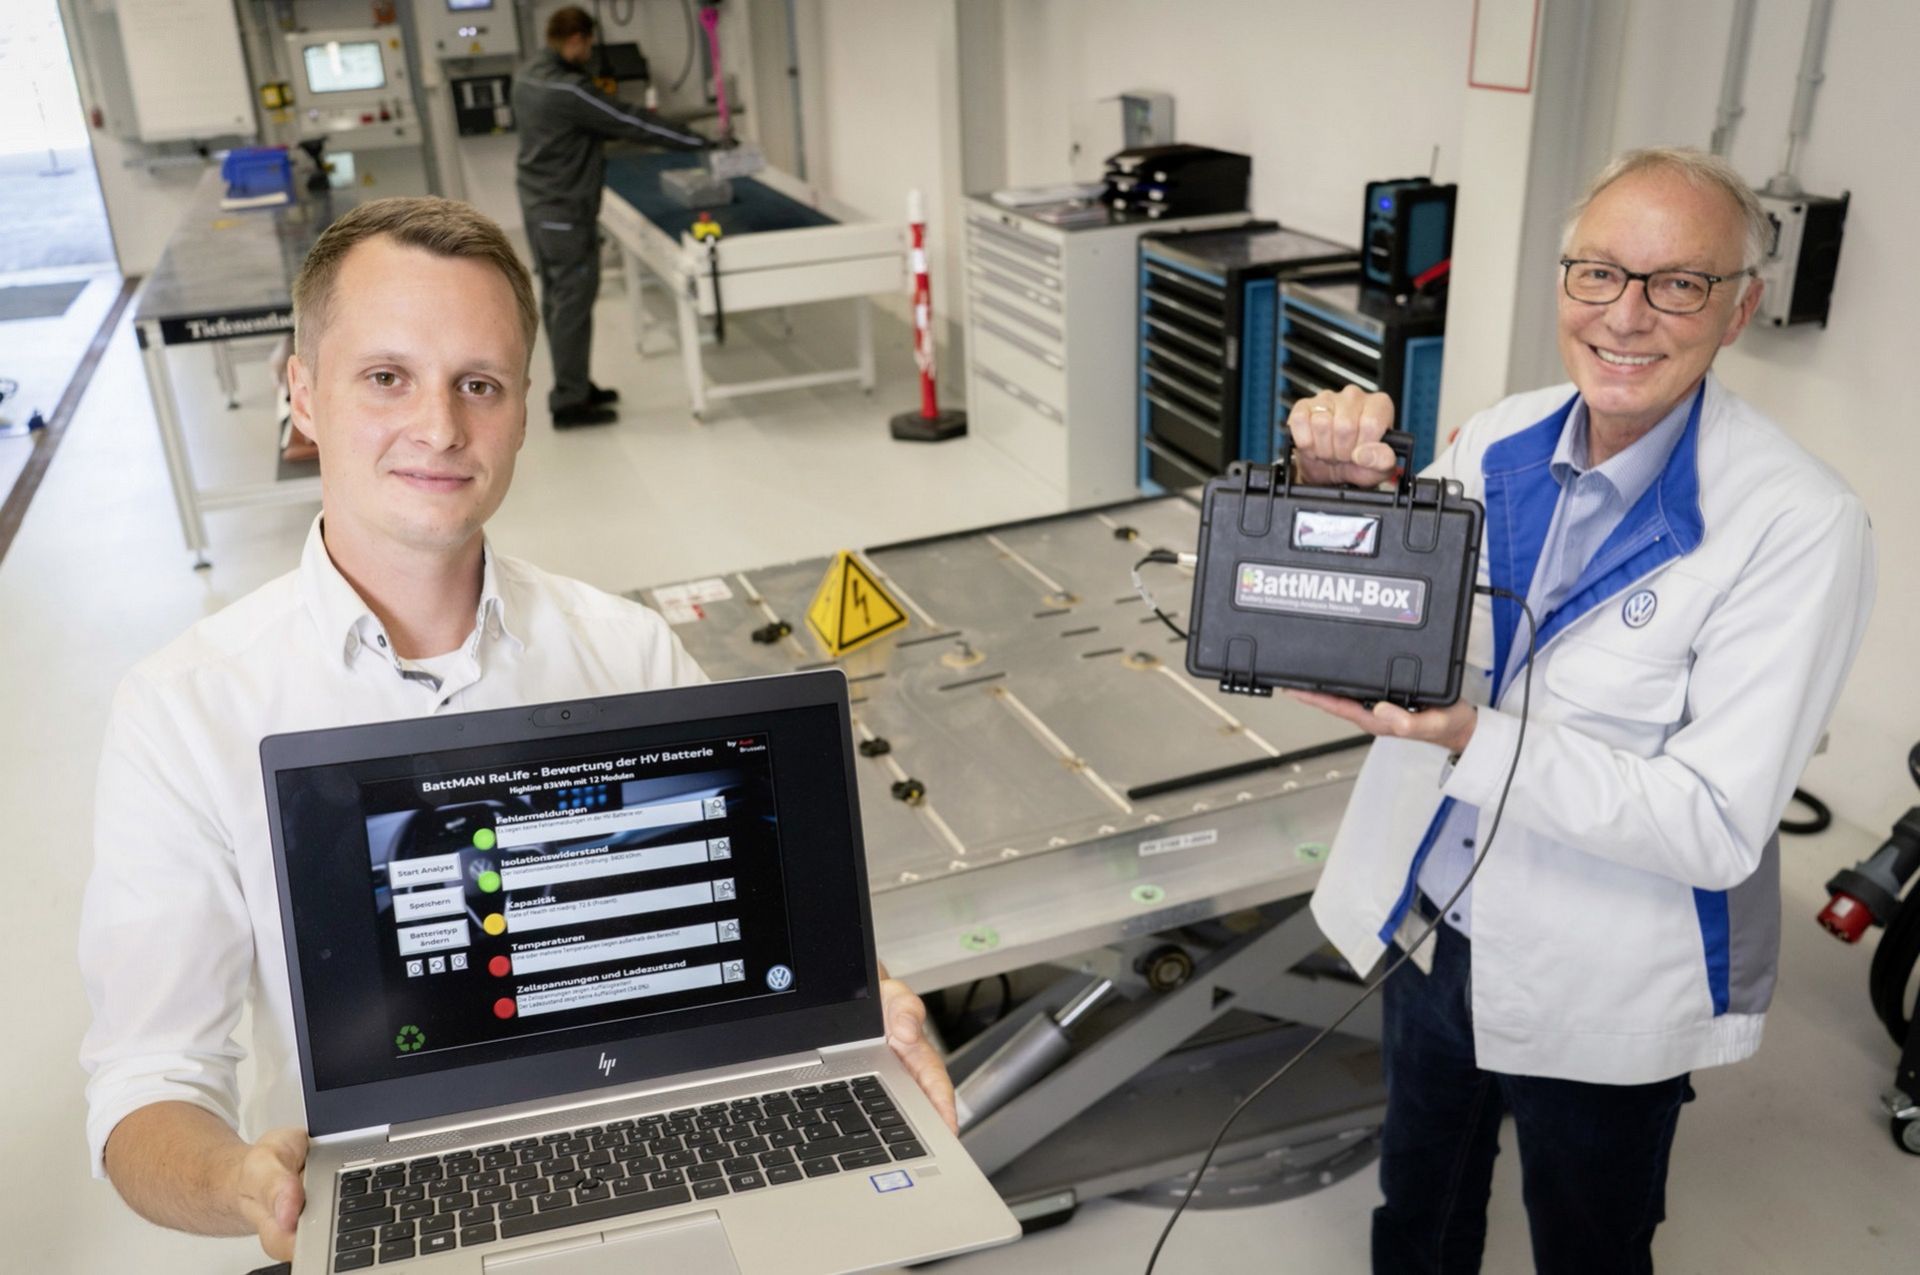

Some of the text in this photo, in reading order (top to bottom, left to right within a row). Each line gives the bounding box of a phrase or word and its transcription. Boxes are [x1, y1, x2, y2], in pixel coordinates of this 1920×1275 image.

[1242, 568, 1410, 608] BattMAN-Box
[727, 740, 737, 748] by
[740, 744, 766, 754] Brussels
[422, 775, 486, 793] BattMAN
[489, 770, 531, 784] ReLife
[541, 760, 613, 778] Bewertung
[616, 757, 637, 769] der
[640, 754, 660, 765] HV
[662, 747, 714, 763] Batterie
[509, 783, 542, 796] Highline
[574, 776, 588, 785] mit
[589, 775, 600, 784] 12
[601, 771, 635, 784] Modulen
[495, 806, 588, 826] Fehlermeldungen
[500, 845, 609, 868] Isolationswiderstand
[421, 864, 454, 875] Analyse
[409, 898, 451, 911] Speichern
[506, 895, 556, 910] Kapazität
[410, 927, 458, 940] Batterietyp
[420, 937, 450, 948] ändern
[511, 934, 586, 952] Temperaturen
[563, 942, 600, 955] Temperaturen
[516, 960, 687, 995] Zellspannungen und Ladezustand
[599, 1052, 616, 1076] hp
